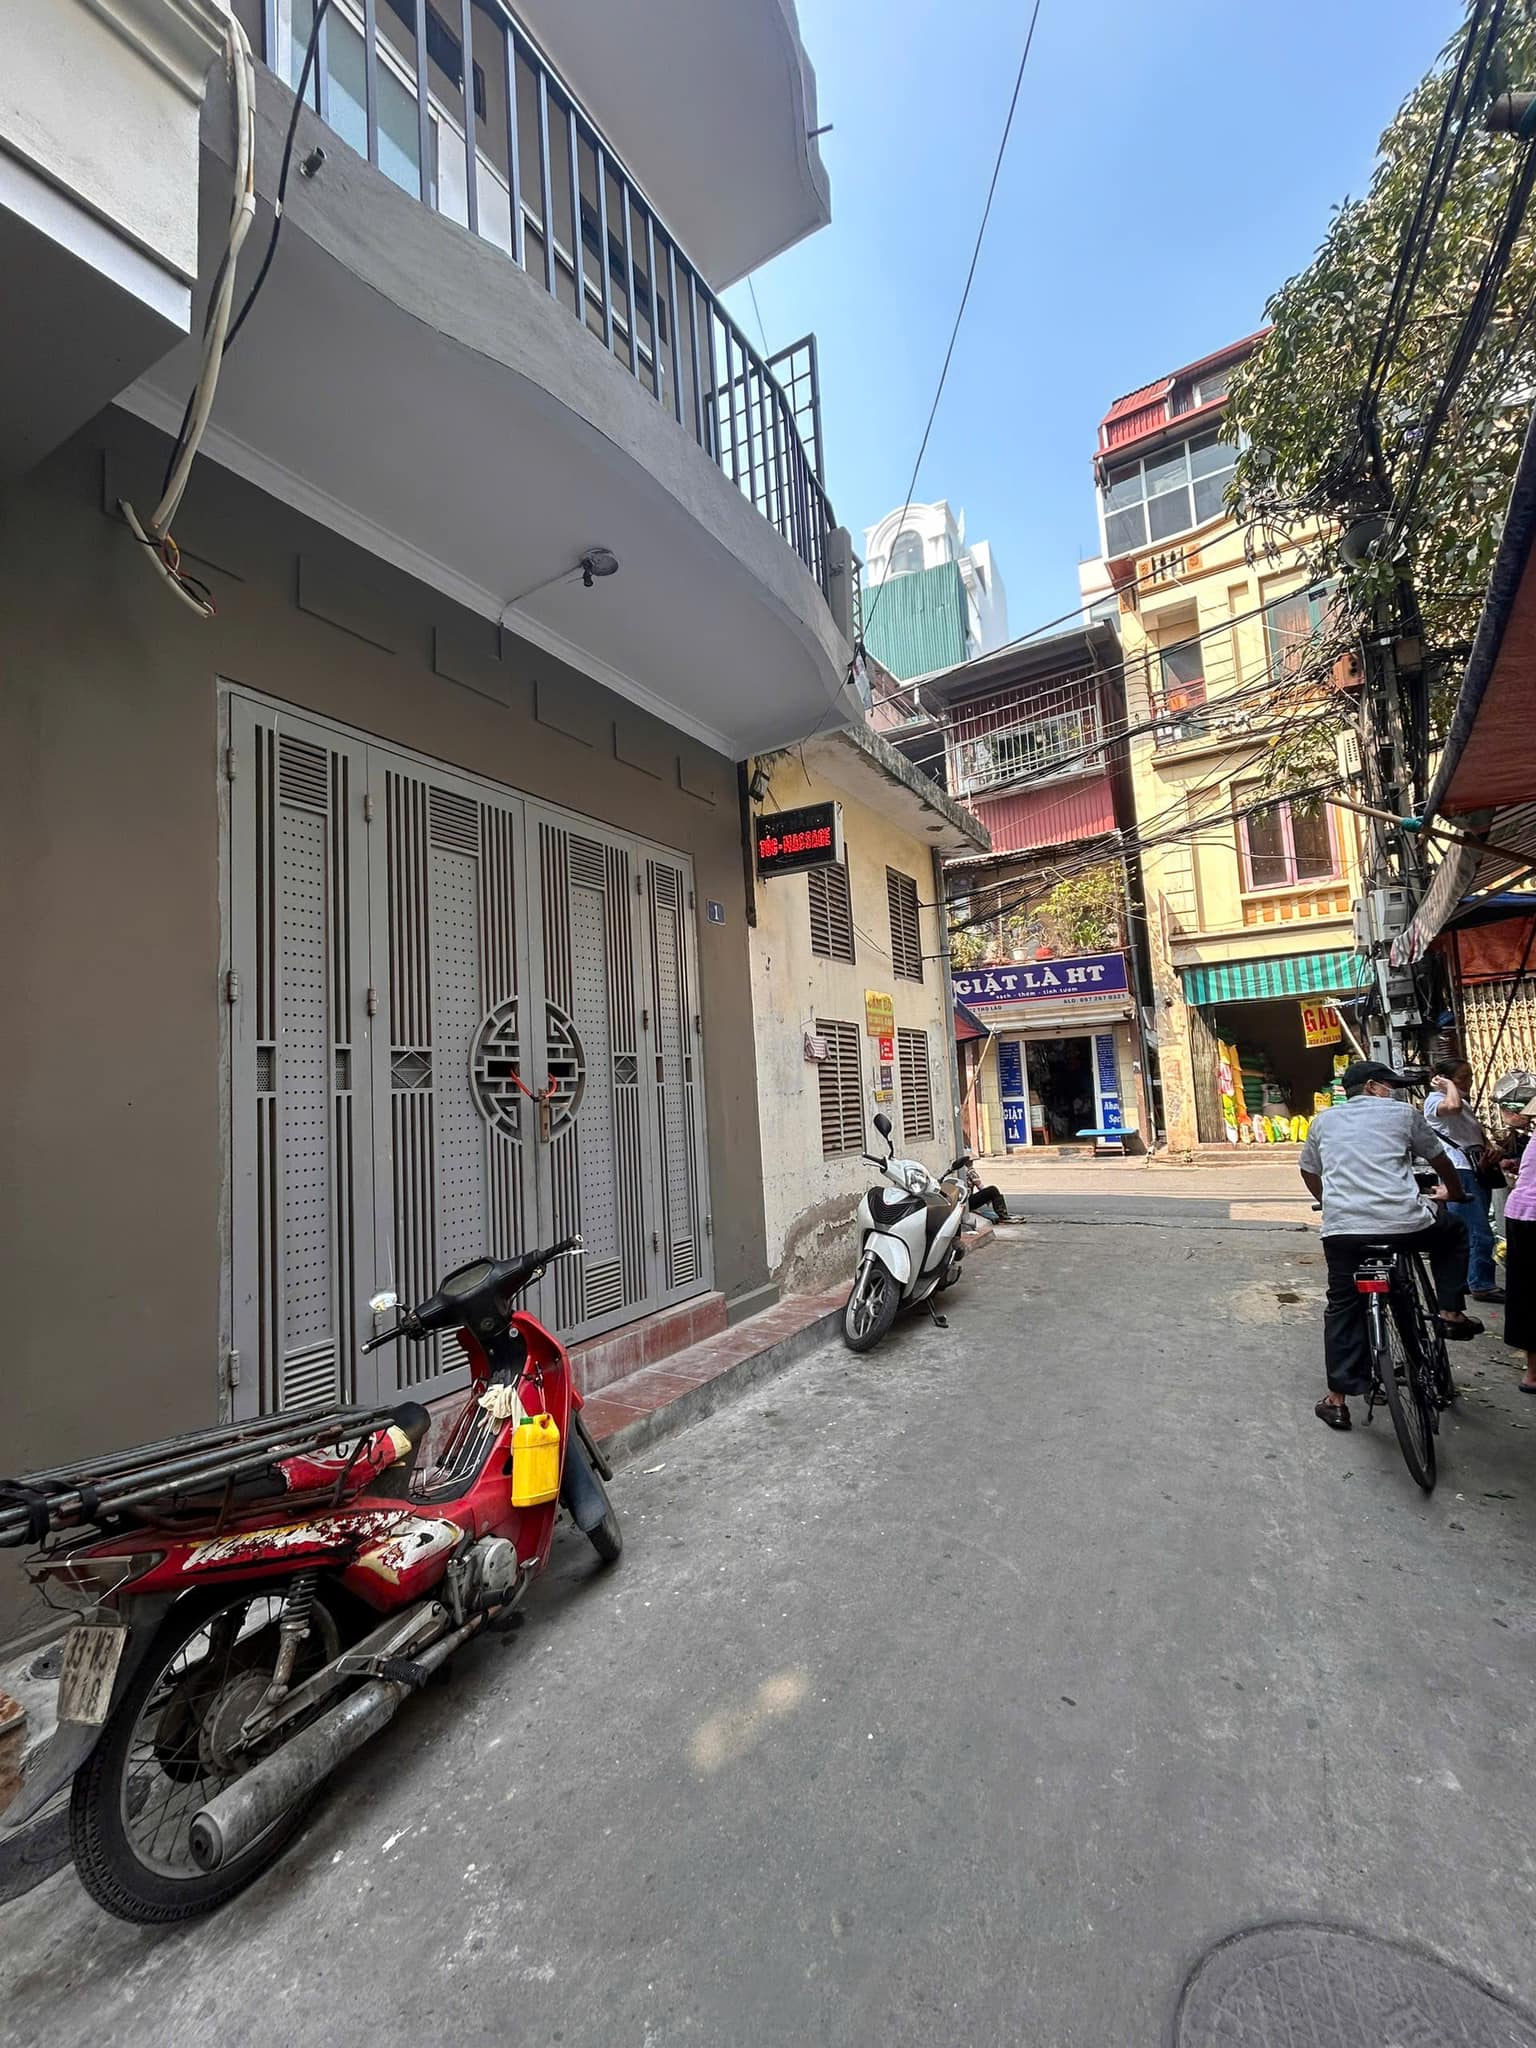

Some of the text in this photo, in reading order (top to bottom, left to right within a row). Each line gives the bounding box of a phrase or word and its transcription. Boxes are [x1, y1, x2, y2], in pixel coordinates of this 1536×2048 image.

[956, 964, 1105, 996] GIẶT LÀ HT
